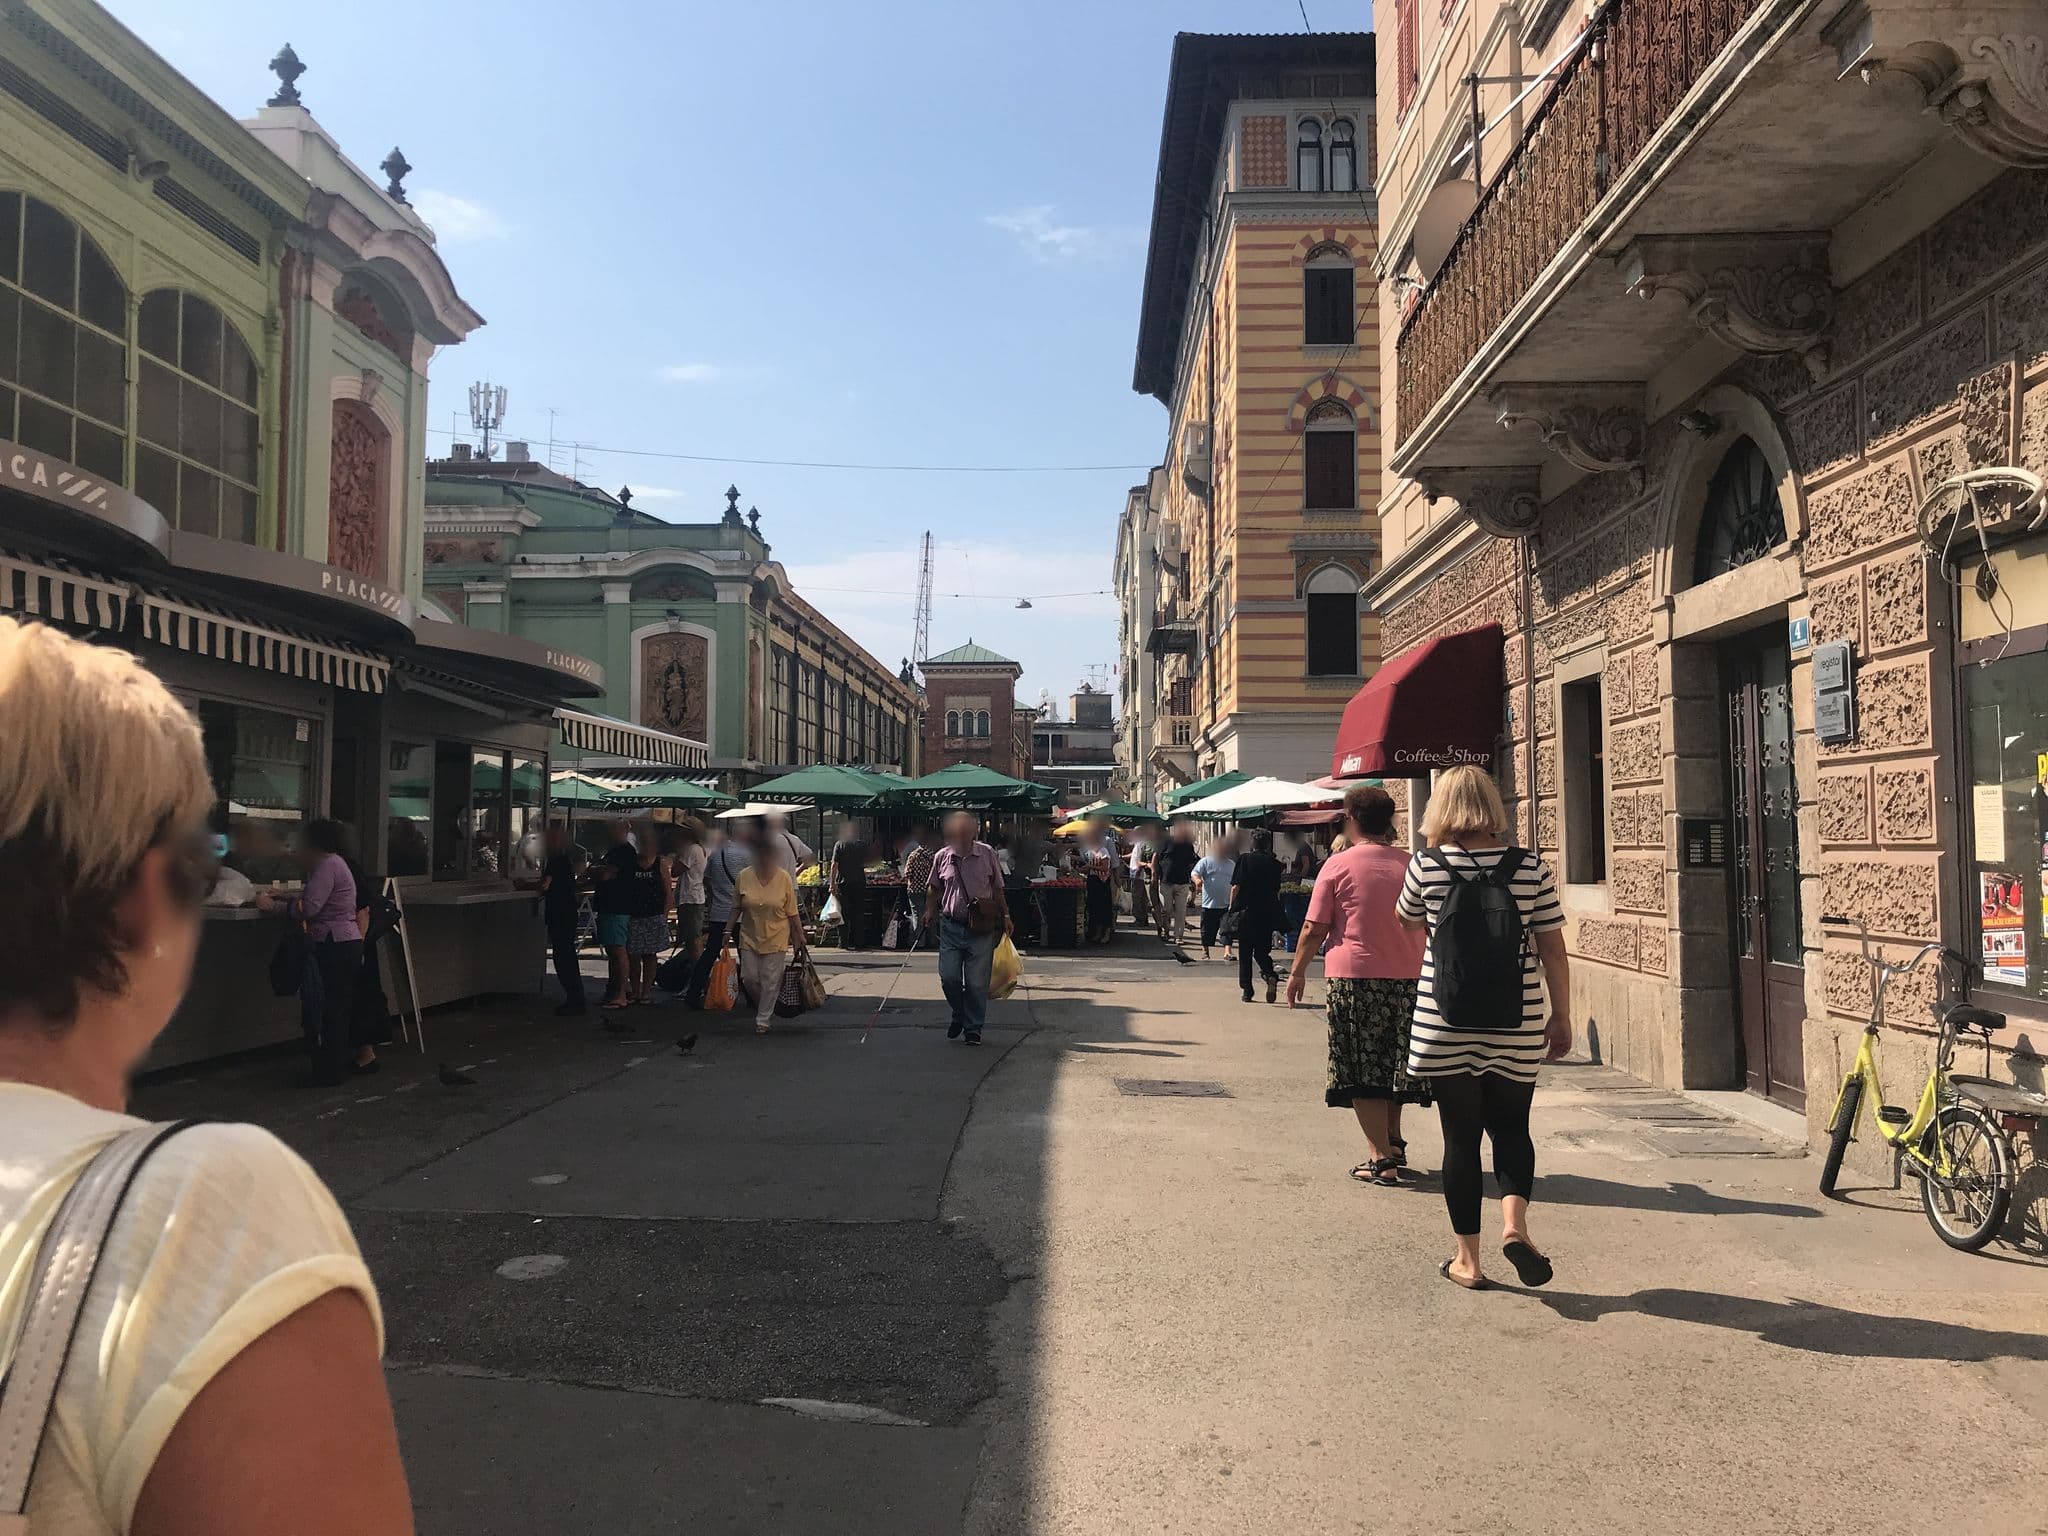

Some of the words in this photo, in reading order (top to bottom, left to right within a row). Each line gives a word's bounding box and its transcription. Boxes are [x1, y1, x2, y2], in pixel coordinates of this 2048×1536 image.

[0, 454, 48, 488] CA
[322, 571, 377, 604] PLACA
[1794, 621, 1801, 640] 4
[546, 650, 575, 672] PLACA
[1394, 748, 1440, 763] Coffee
[1453, 748, 1490, 765] Shop
[749, 793, 788, 802] PLACA
